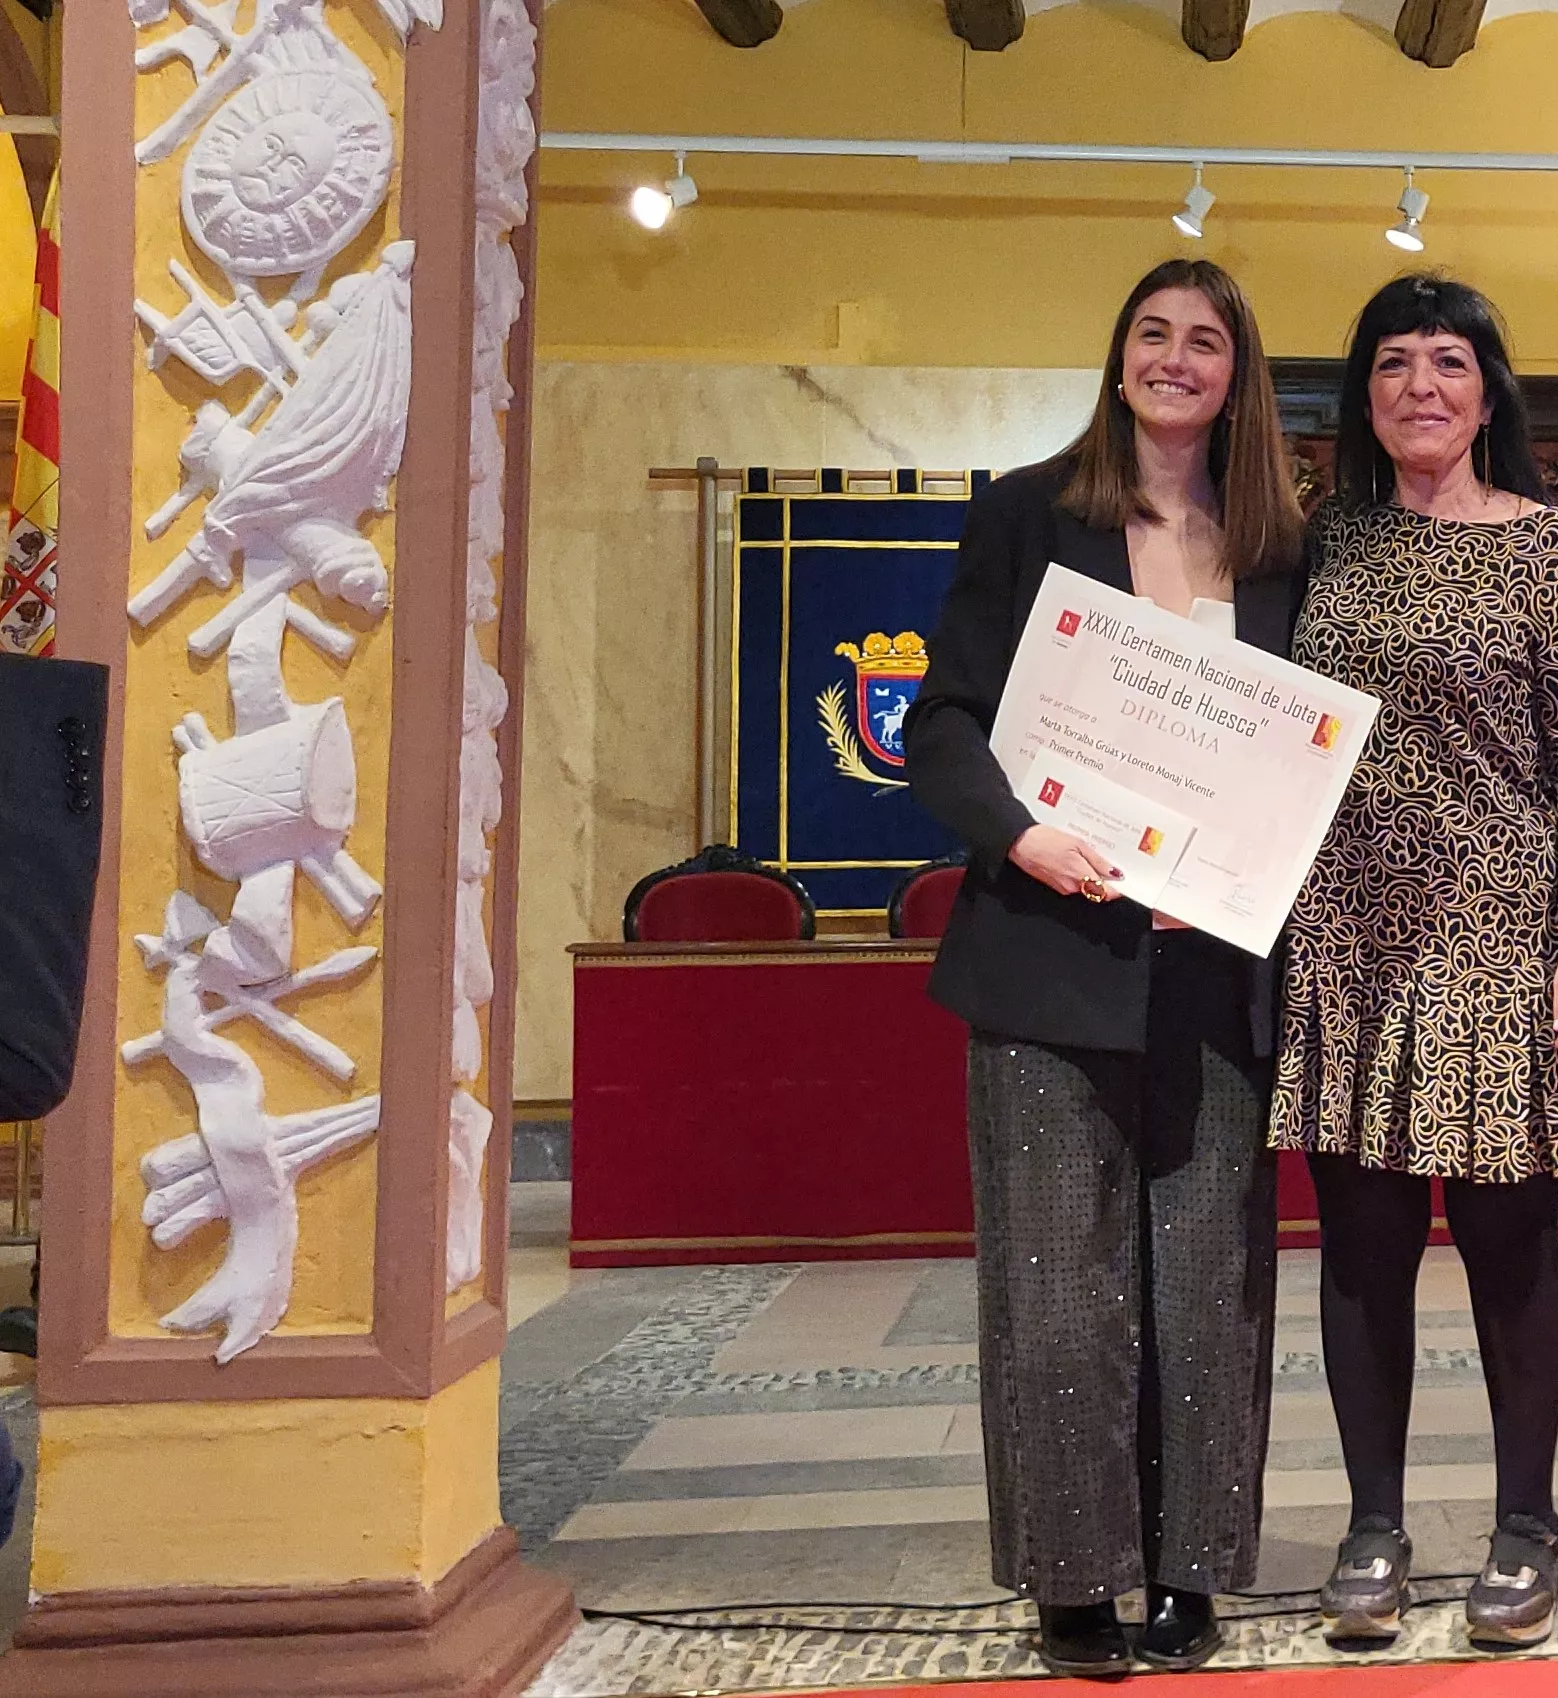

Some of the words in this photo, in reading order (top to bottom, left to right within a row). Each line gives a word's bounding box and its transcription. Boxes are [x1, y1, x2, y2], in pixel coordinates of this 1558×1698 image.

[1082, 608, 1121, 641] XXXII
[1120, 625, 1193, 673] Certamen
[1194, 656, 1262, 701] Nacional
[1260, 686, 1280, 709] de
[1282, 695, 1318, 725] Jota
[1110, 654, 1172, 700] "Ciudad
[1171, 684, 1193, 710] de
[1195, 692, 1270, 738] Huesca"
[1063, 704, 1090, 721] otorga
[1120, 698, 1220, 754] DIPLOMA
[1039, 715, 1062, 733] Marta
[1063, 724, 1094, 747] Torralba
[1119, 751, 1127, 763] y
[1127, 752, 1155, 773] Loreto
[1155, 765, 1184, 787] Monaj
[1184, 776, 1216, 799] Vicente
[1049, 738, 1075, 758] Primer
[1075, 750, 1105, 772] Premio
